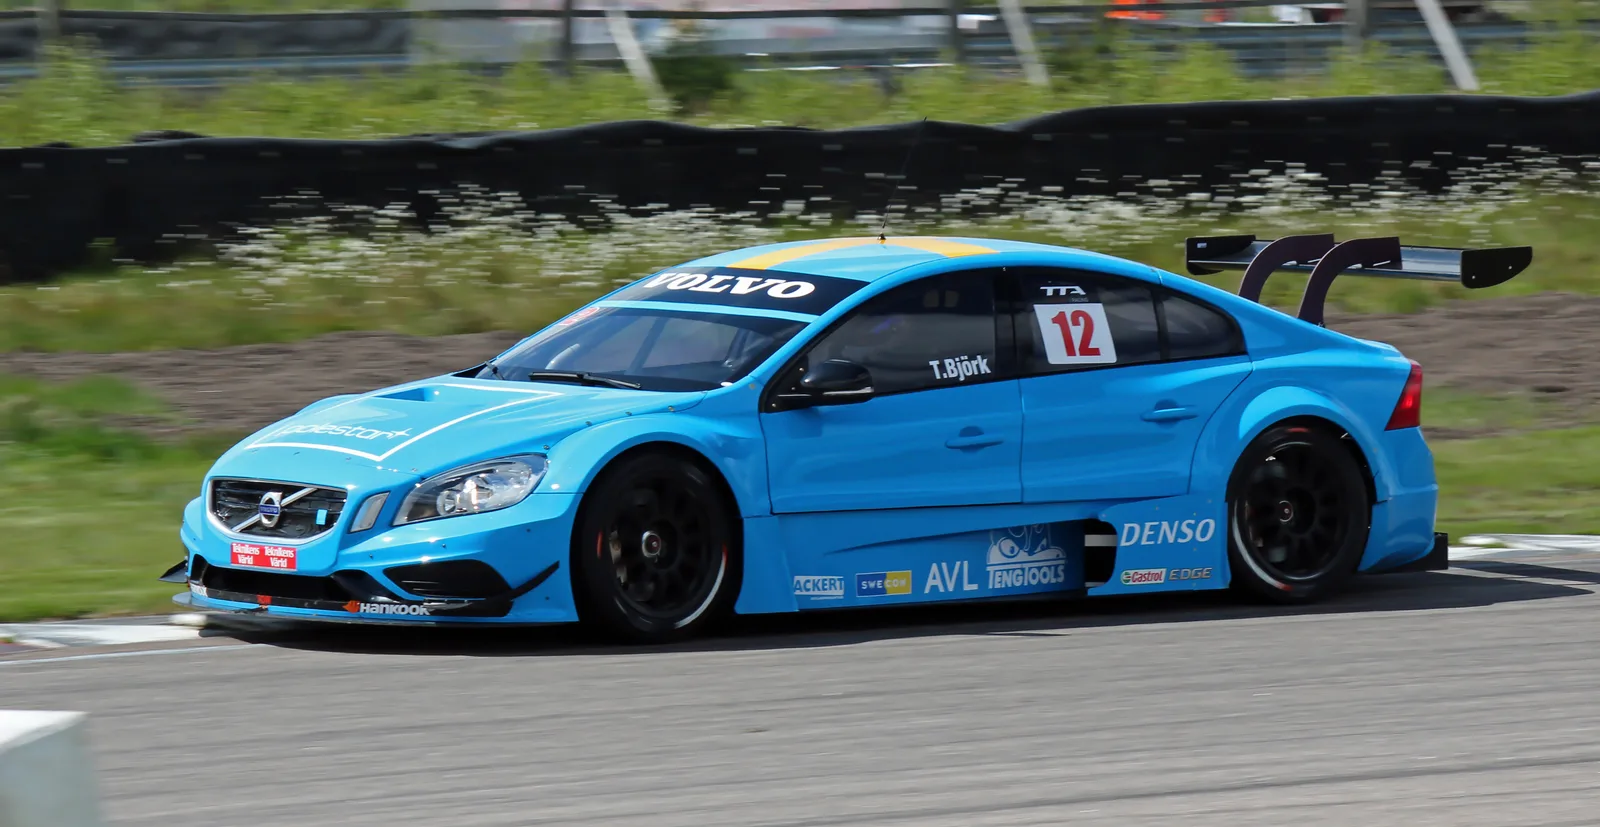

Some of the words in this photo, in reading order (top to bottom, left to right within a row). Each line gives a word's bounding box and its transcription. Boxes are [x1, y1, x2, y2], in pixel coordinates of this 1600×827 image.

[643, 272, 816, 299] VOLVO
[1040, 286, 1086, 296] TTA
[1051, 310, 1101, 357] 12
[928, 355, 992, 382] T.Björk
[1120, 518, 1216, 547] DENSO
[924, 561, 979, 594] AVL
[1131, 571, 1163, 583] Castrol
[1169, 567, 1212, 580] EDGE
